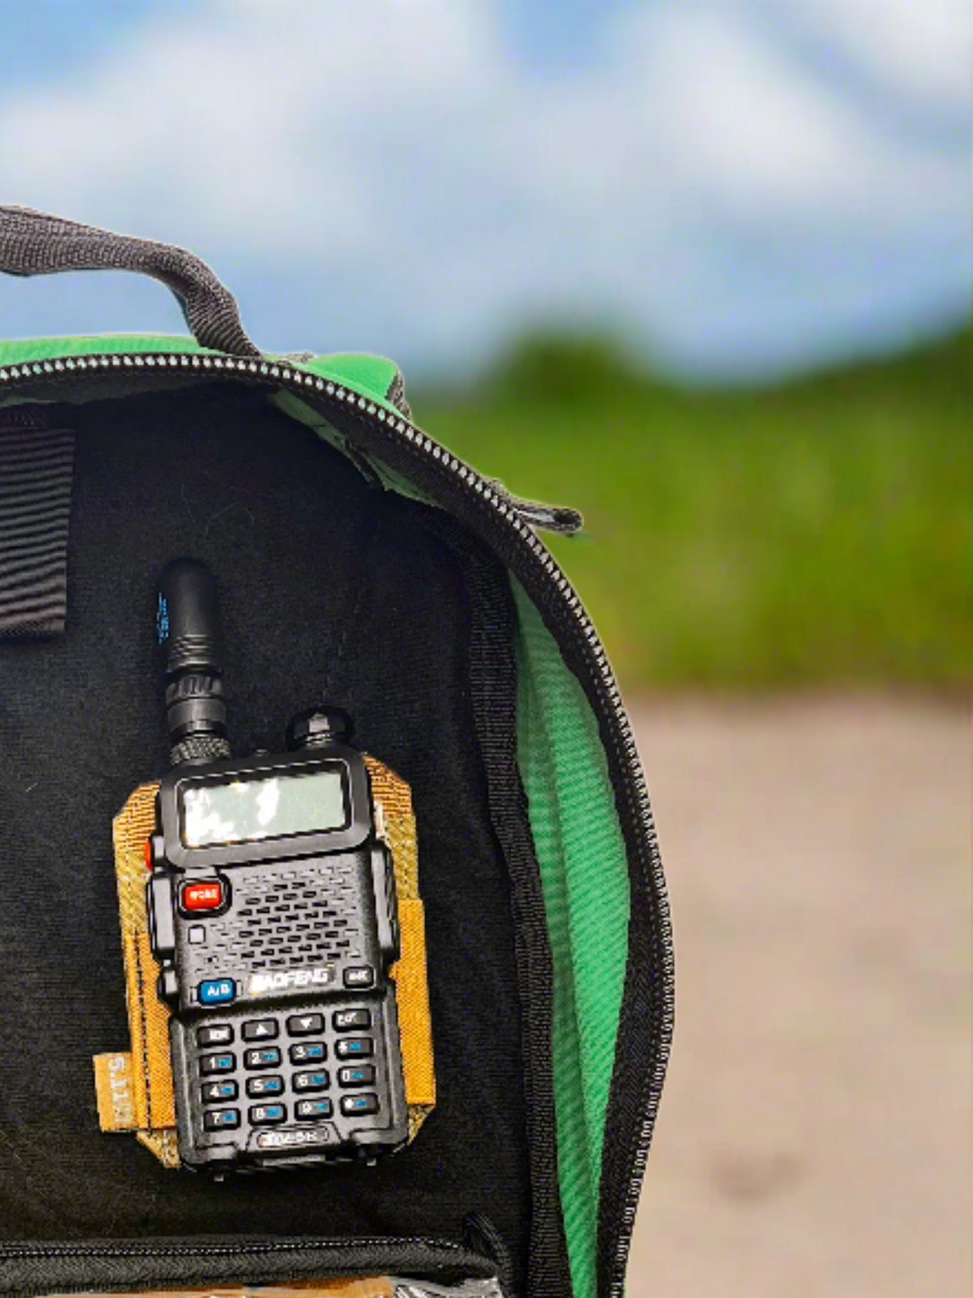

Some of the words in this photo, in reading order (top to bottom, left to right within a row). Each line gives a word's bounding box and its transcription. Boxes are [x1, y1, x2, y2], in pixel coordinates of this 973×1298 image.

[251, 1052, 261, 1065] 2
[295, 1046, 306, 1058] 3
[210, 1085, 220, 1097] 4
[253, 1079, 264, 1091] 5
[298, 1074, 308, 1086] 6
[212, 1112, 220, 1124] 7
[256, 1108, 265, 1119] 8
[302, 1102, 313, 1114] 9
